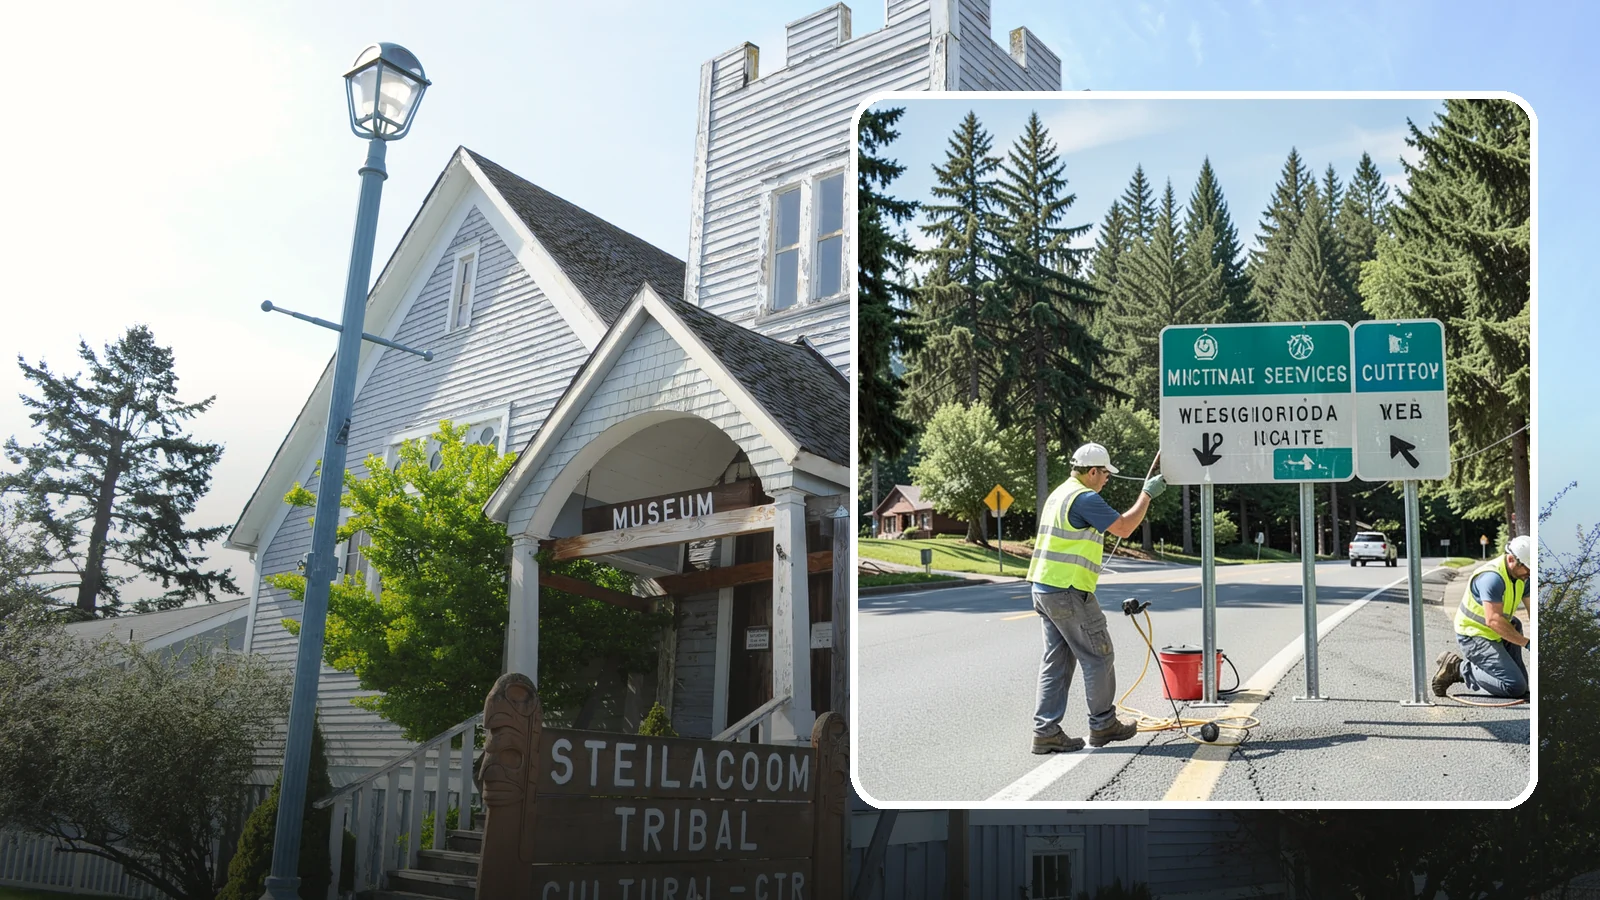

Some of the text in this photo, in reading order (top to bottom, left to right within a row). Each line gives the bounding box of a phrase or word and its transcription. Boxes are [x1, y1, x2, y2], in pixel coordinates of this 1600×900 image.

[613, 491, 713, 530] MUSEUM
[551, 738, 810, 792] STEILACOOM
[614, 806, 758, 852] TRIBAL
